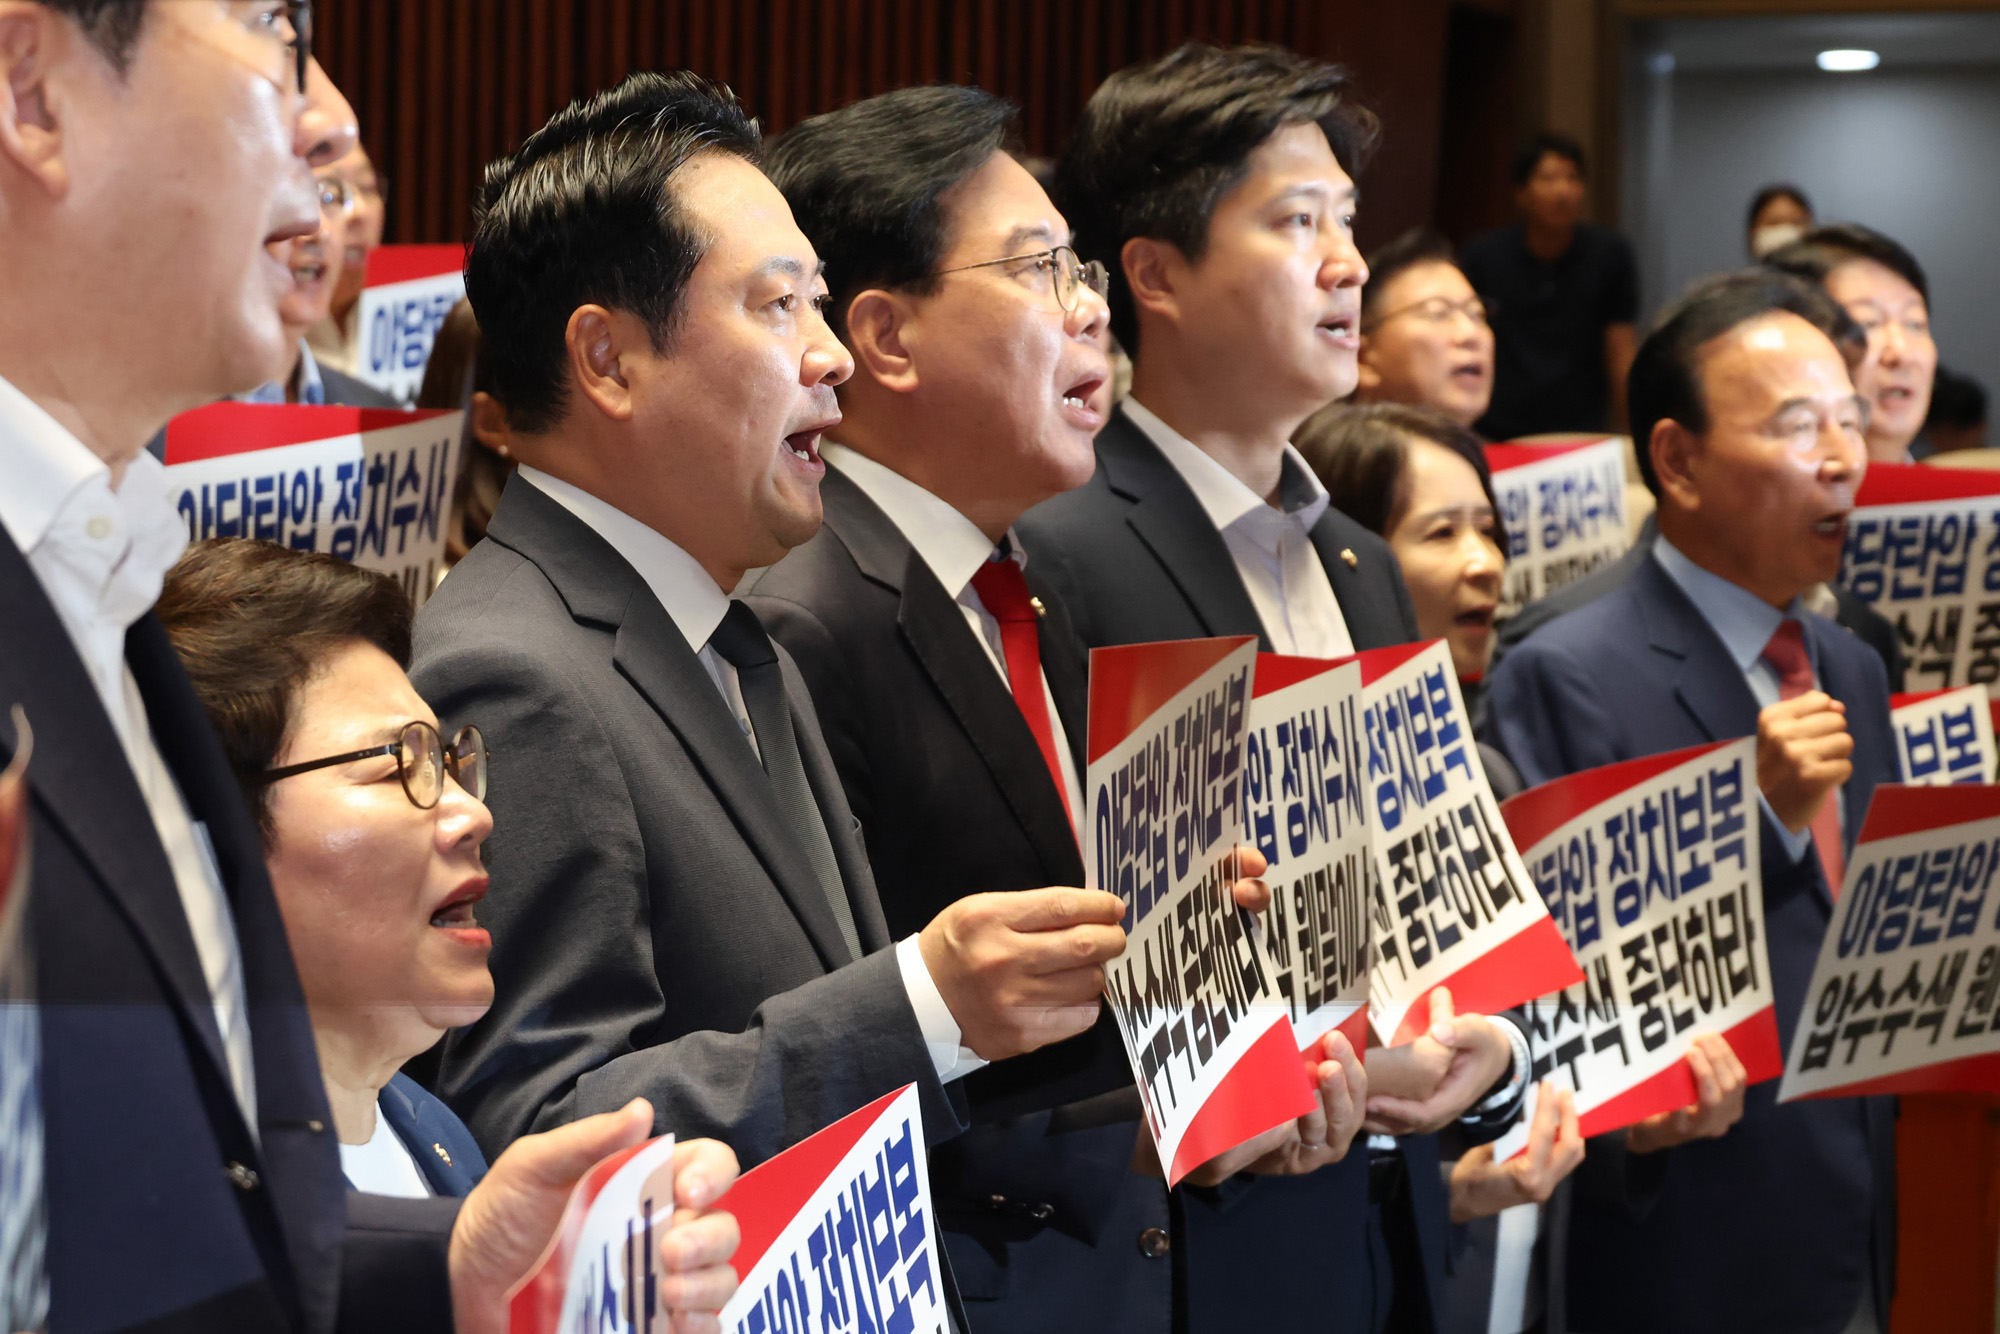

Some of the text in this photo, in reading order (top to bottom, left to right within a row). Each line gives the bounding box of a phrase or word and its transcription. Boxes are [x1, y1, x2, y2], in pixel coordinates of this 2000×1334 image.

[331, 438, 447, 562] 정치수사
[1173, 664, 1247, 883] 정치보복
[1276, 696, 1365, 858] 정치수사
[1364, 662, 1474, 833] 정치보복
[1387, 793, 1527, 970] 중단하라
[1604, 757, 1748, 928] 정치보복
[1838, 838, 2000, 959] 야당탄압
[1177, 843, 1270, 1068] 중단하라
[1620, 882, 1759, 1053] 중단하라
[1799, 950, 1969, 1075] 압수수색
